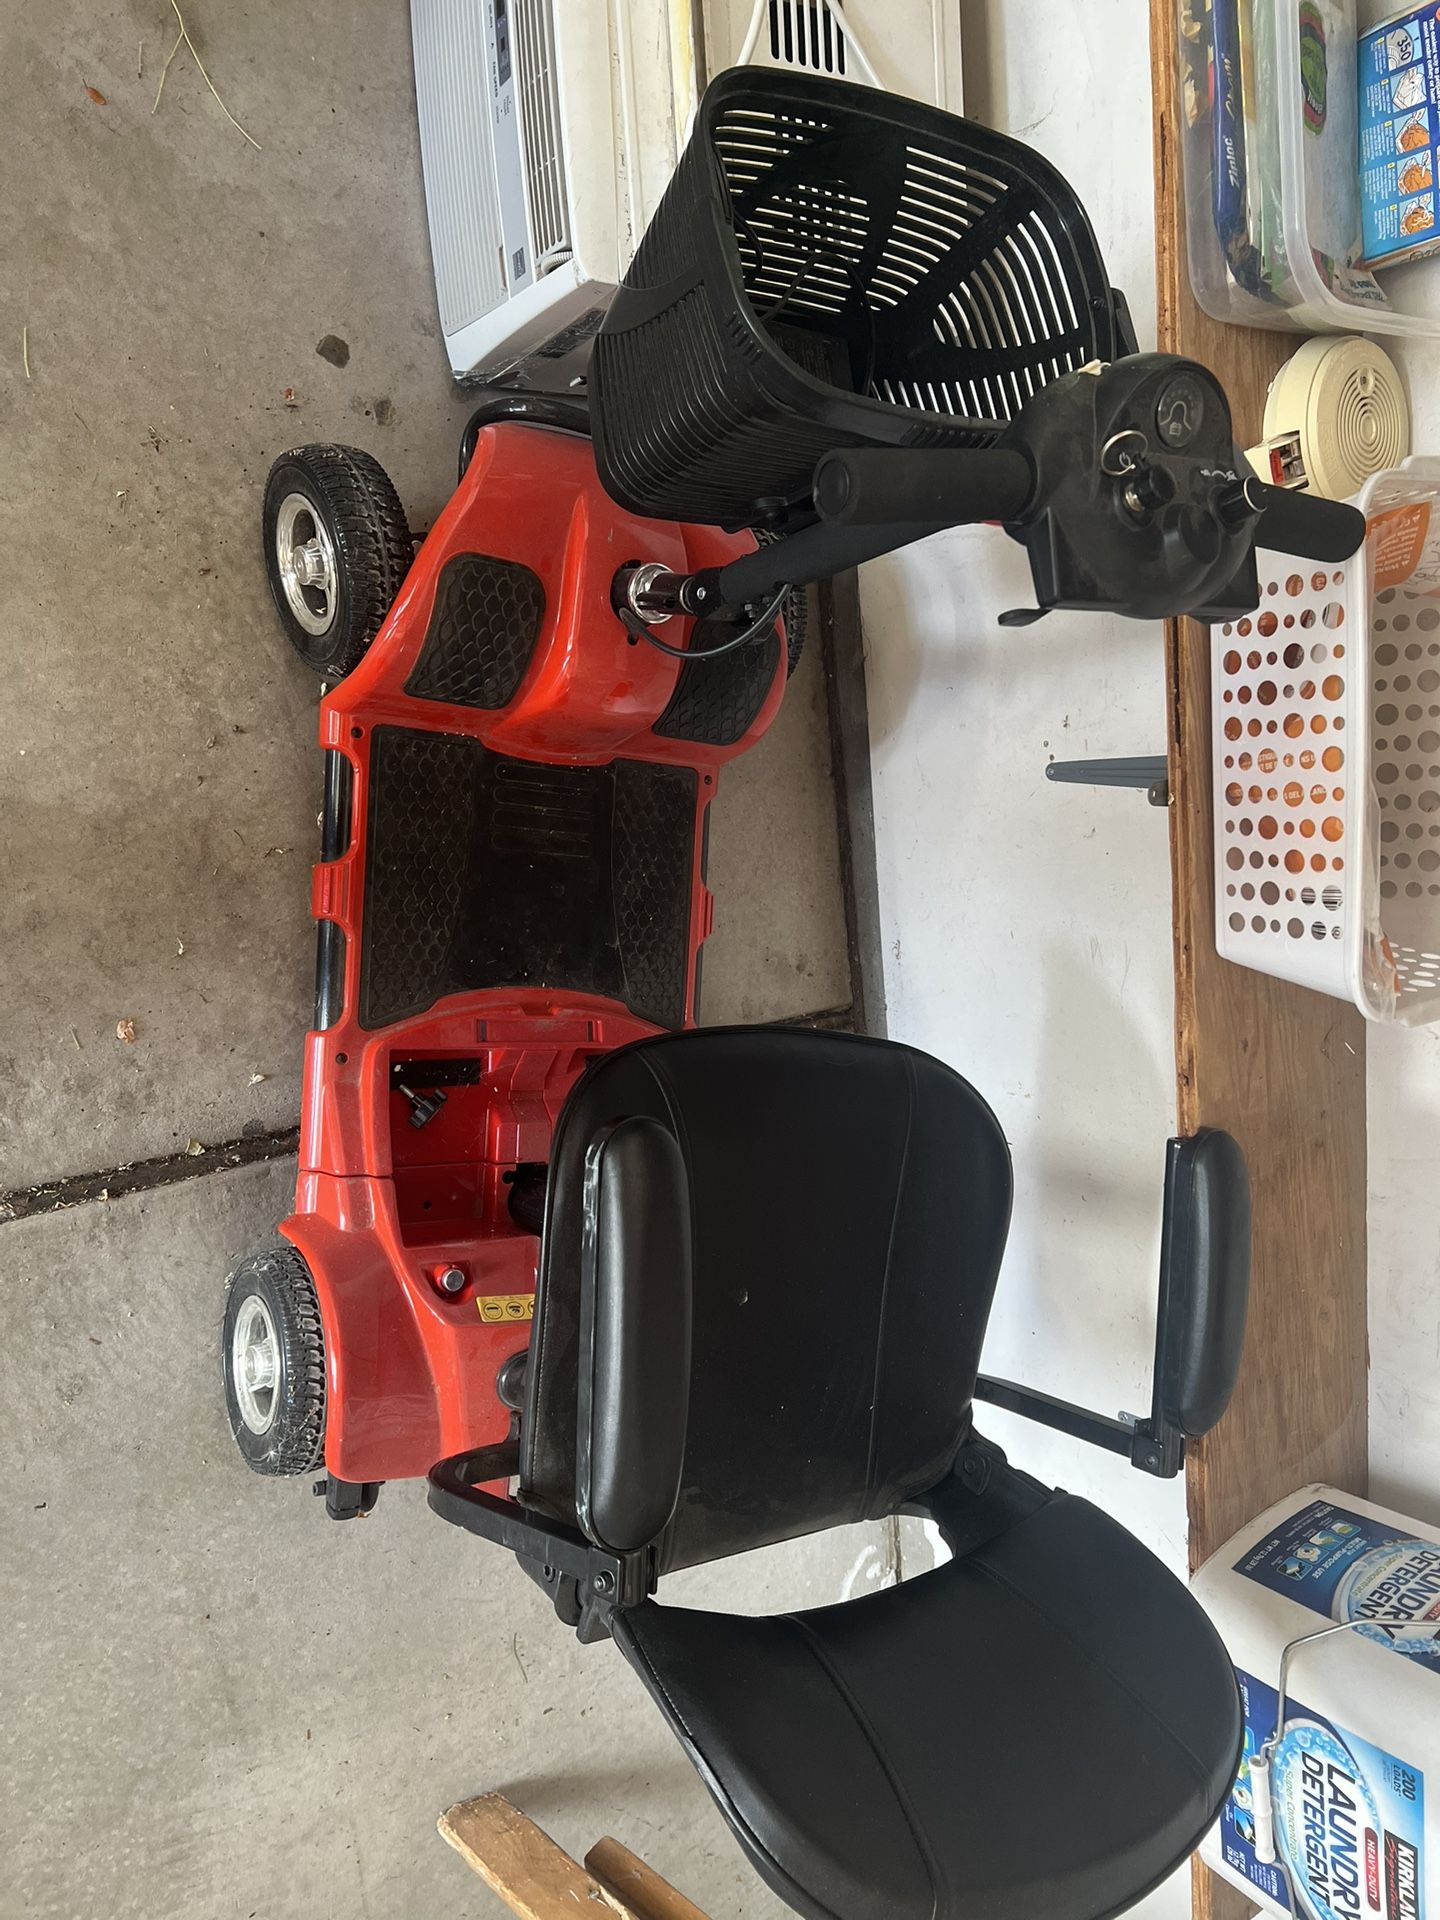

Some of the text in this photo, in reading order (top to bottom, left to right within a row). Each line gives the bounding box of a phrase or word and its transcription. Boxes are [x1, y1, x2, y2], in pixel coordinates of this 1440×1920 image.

[1397, 36, 1412, 61] 350
[1224, 137, 1240, 188] Ziploc
[1310, 1567, 1328, 1580] USE
[1352, 1566, 1386, 1596] Concentrate
[1354, 1550, 1440, 1621] DETERGENT
[1377, 1563, 1440, 1640] UNDRY
[1284, 1769, 1298, 1860] Super Concentrate
[1401, 1769, 1416, 1801] 200
[1301, 1751, 1330, 1908] DETERGENT
[1328, 1764, 1361, 1920] LAUNDRY
[1367, 1839, 1378, 1902] HEAVY-DUTY
[1398, 1843, 1416, 1920] KIRKLAN
